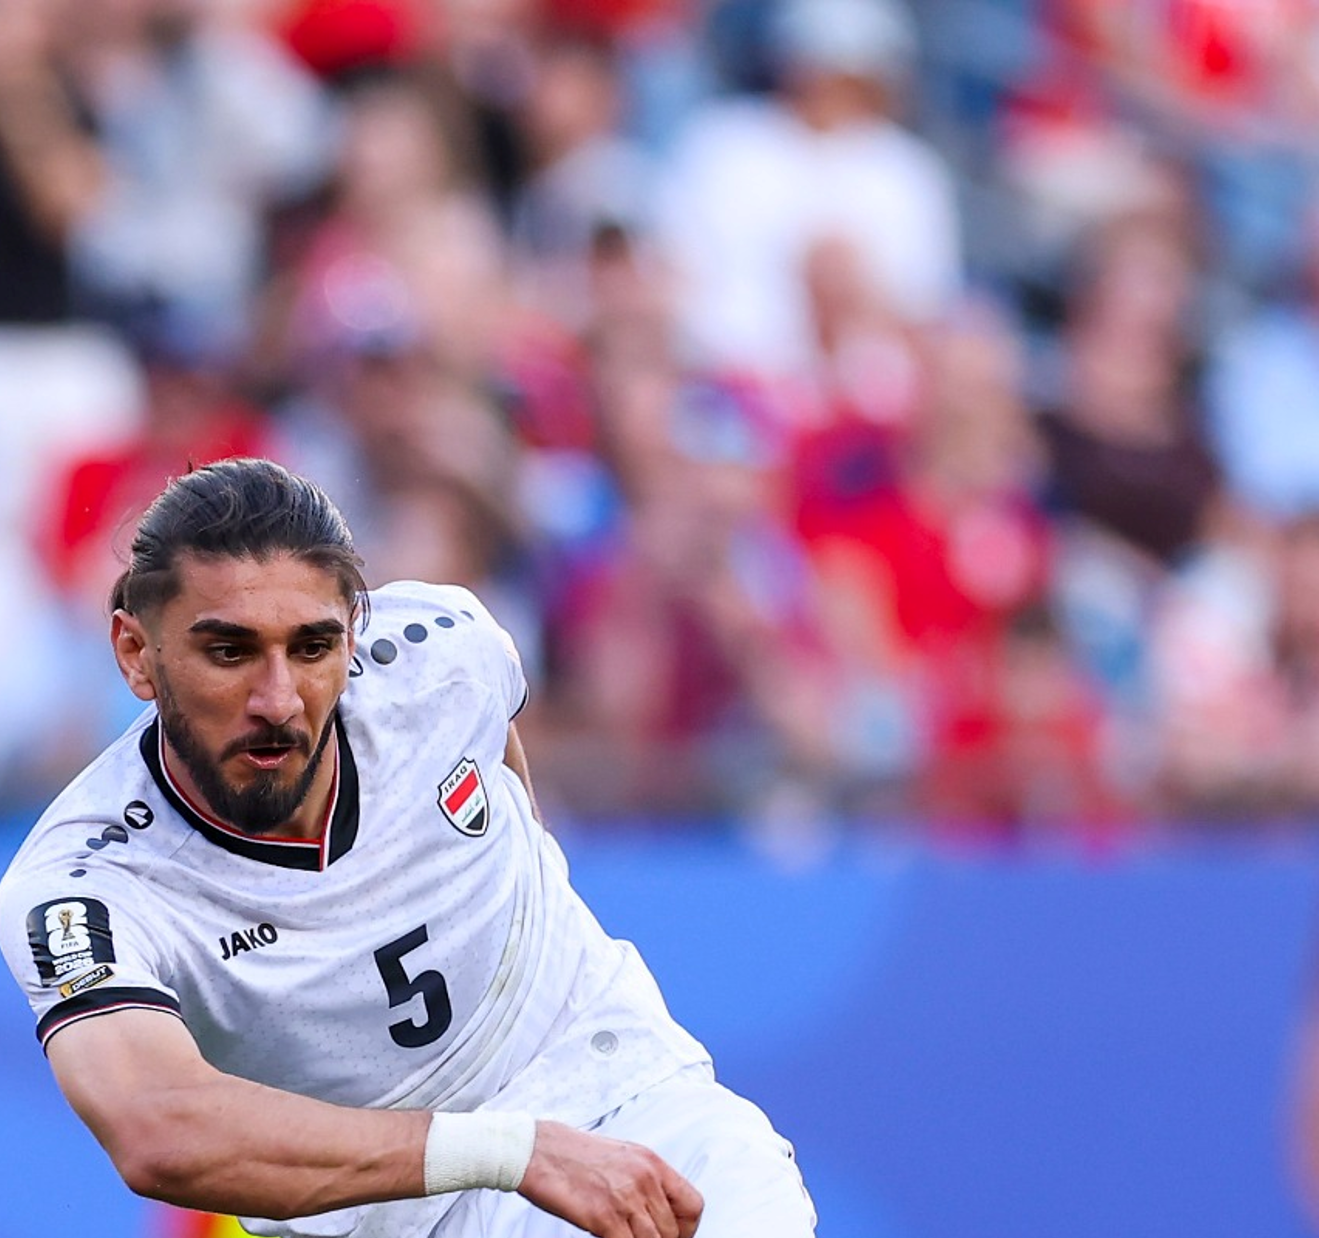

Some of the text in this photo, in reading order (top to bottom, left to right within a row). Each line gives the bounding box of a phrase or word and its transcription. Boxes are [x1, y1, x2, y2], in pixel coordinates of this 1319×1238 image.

[444, 765, 468, 793] IRAQ
[60, 940, 79, 949] FIFA
[218, 922, 278, 961] JAKO
[54, 957, 95, 976] 2026
[72, 966, 108, 991] DEBUT
[373, 923, 452, 1048] 5
